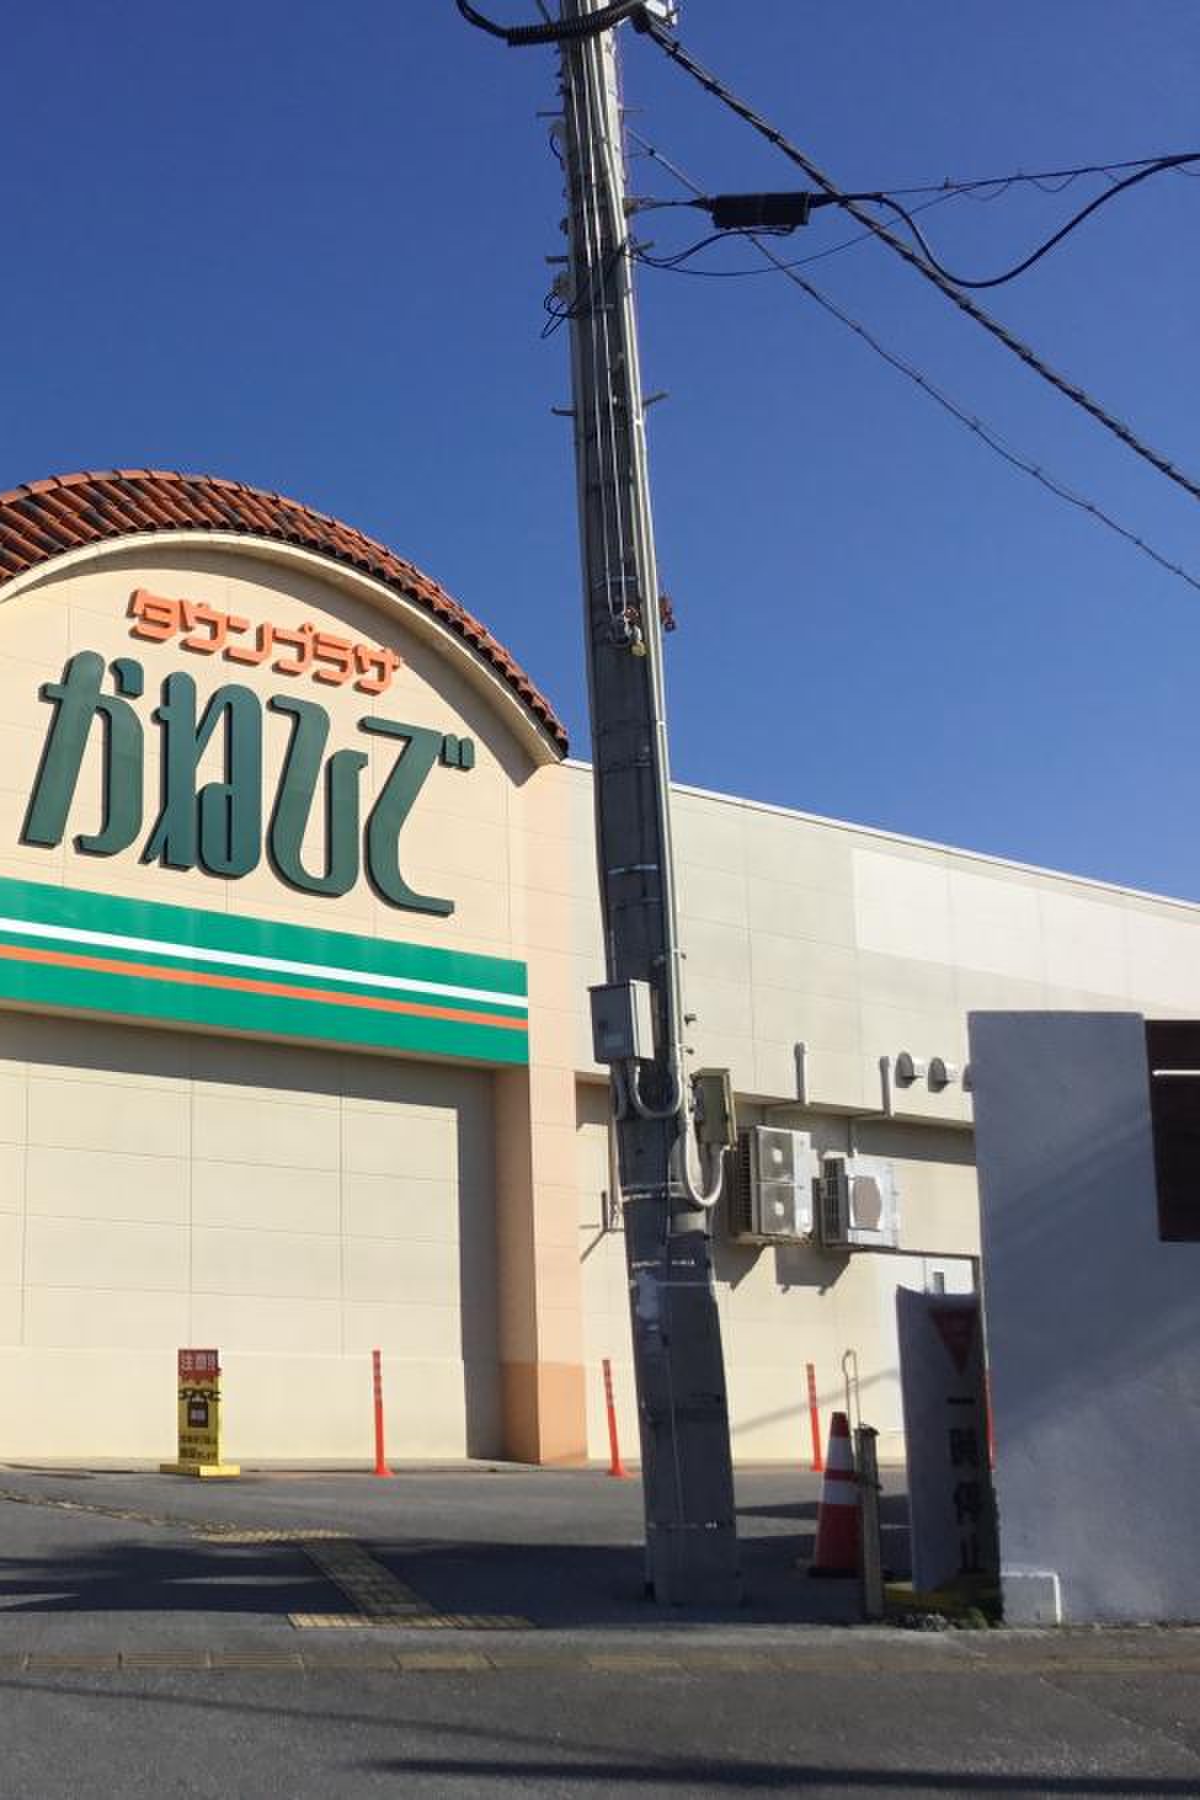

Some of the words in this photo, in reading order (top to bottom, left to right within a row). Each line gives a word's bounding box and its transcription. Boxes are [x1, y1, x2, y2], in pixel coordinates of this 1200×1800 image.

[126, 588, 401, 695] タウンプラザ
[18, 650, 475, 917] かねひで
